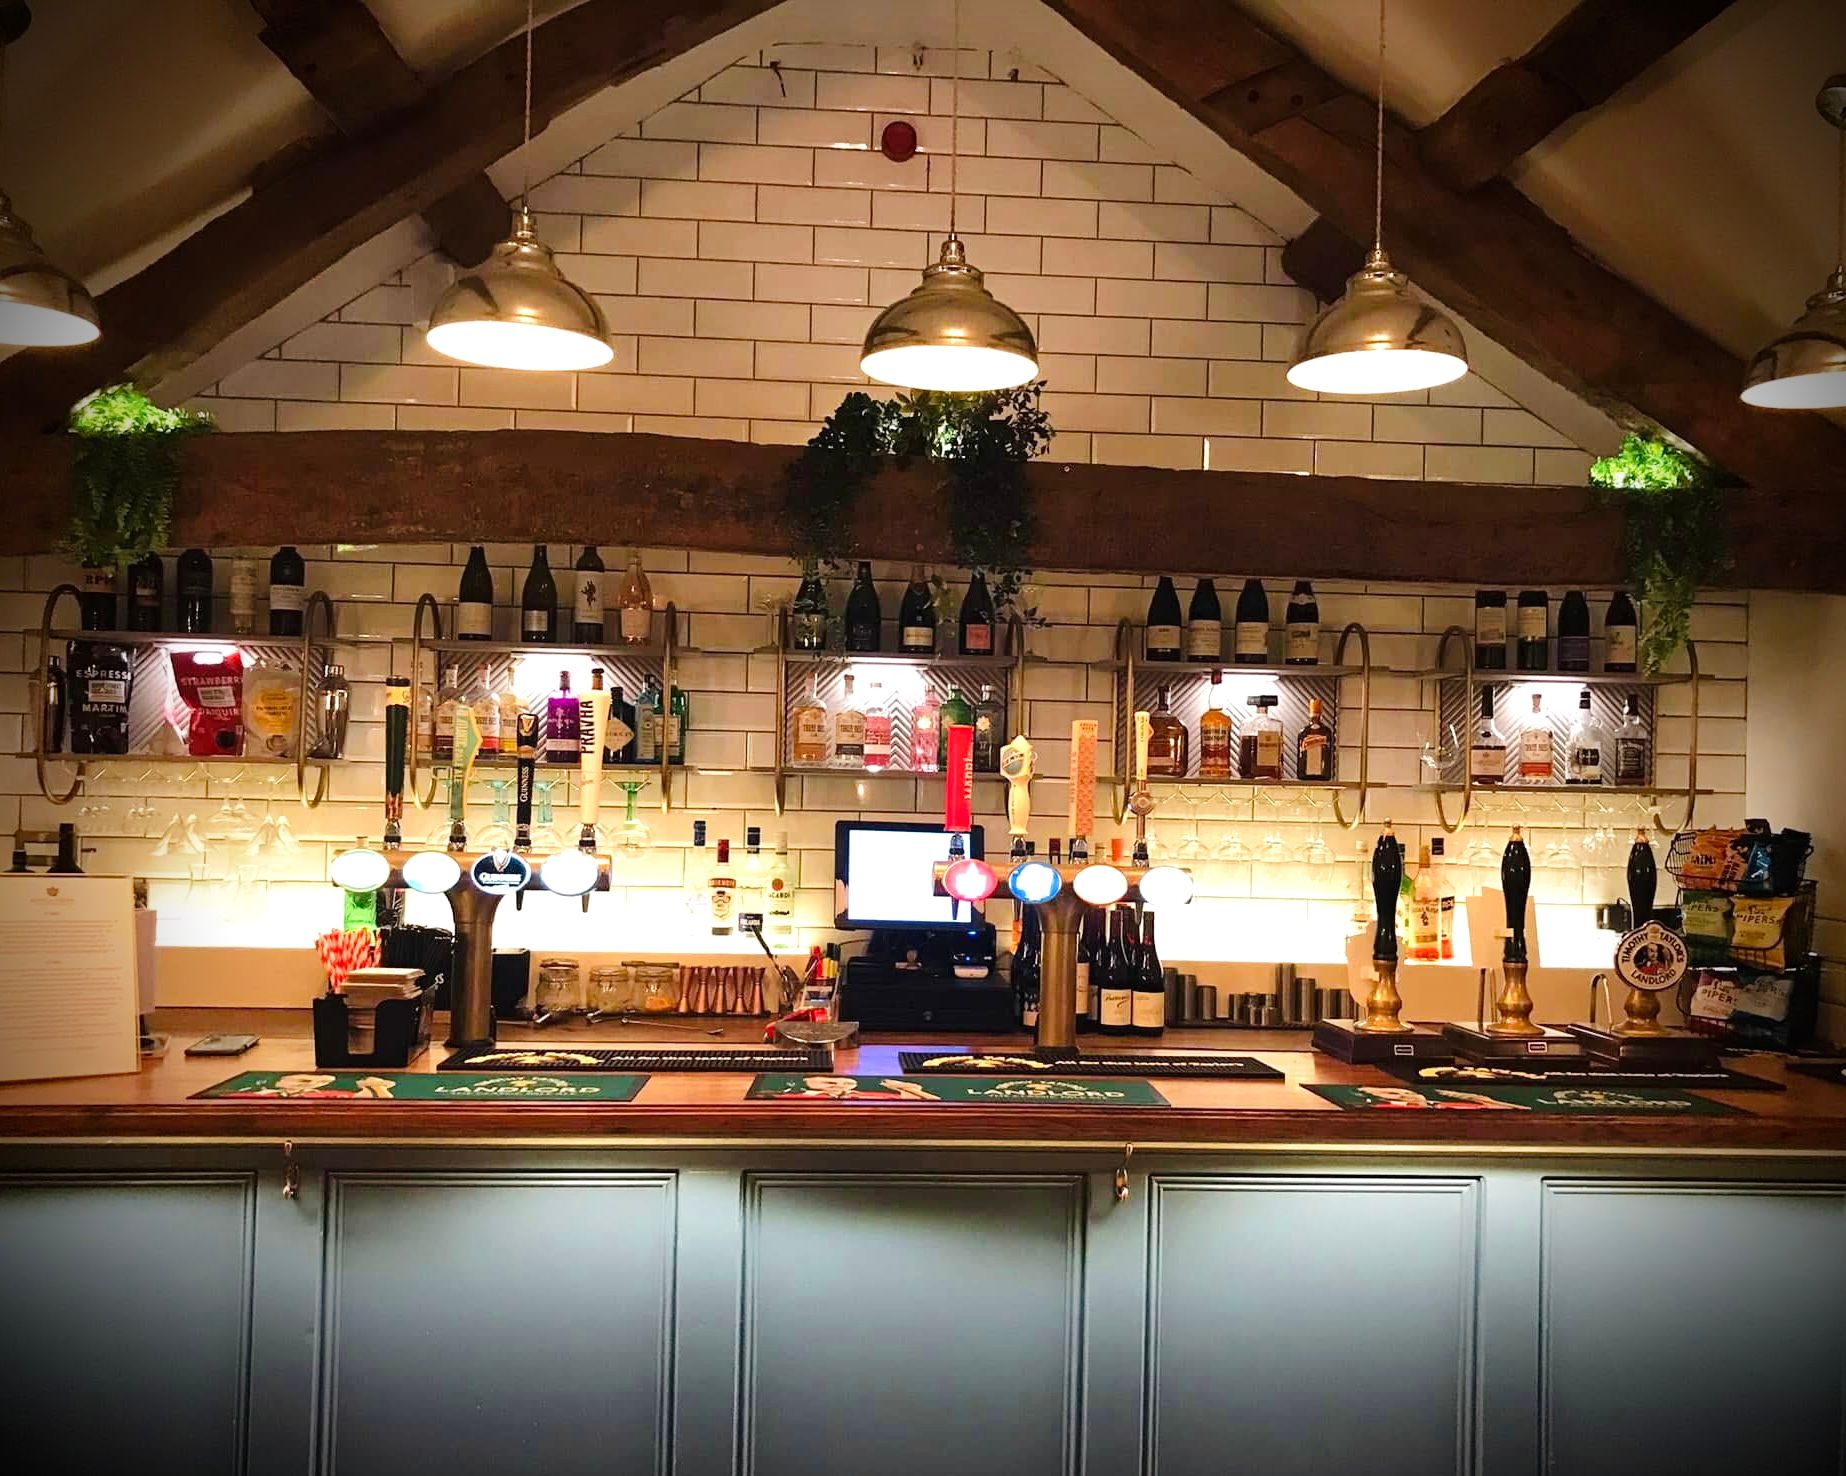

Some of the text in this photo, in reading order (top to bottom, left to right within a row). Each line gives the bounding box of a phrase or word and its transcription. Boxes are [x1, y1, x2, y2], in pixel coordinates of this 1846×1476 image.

[580, 700, 595, 754] PRAVHA
[520, 766, 529, 803] GUINNESS
[1622, 932, 1648, 963] TIMOTHY
[1631, 968, 1676, 985] LANDLORD
[434, 1086, 602, 1095] LANDLORD
[966, 1088, 1125, 1098] LANDLORD
